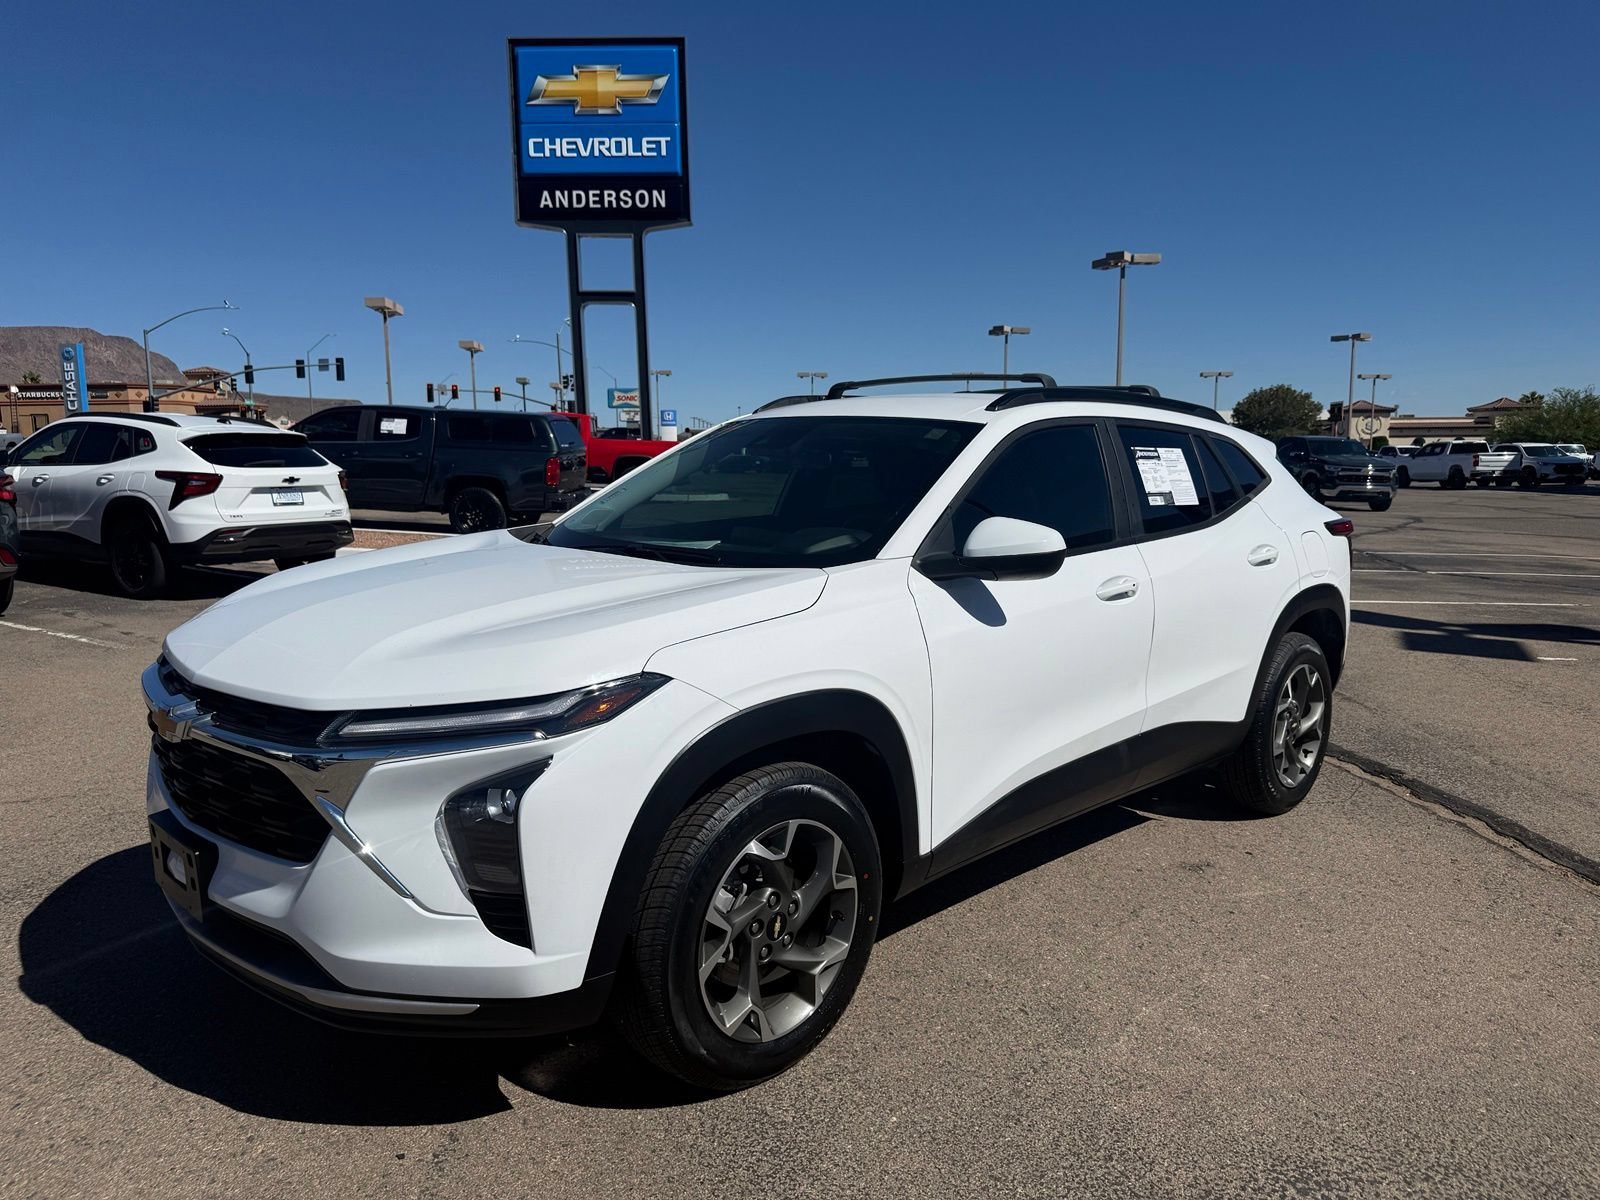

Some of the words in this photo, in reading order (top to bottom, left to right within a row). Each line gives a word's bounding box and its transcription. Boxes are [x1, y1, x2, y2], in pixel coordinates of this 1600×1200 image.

[528, 137, 671, 158] CHEVROLET
[539, 189, 667, 209] ANDERSON
[63, 362, 78, 410] CHASE
